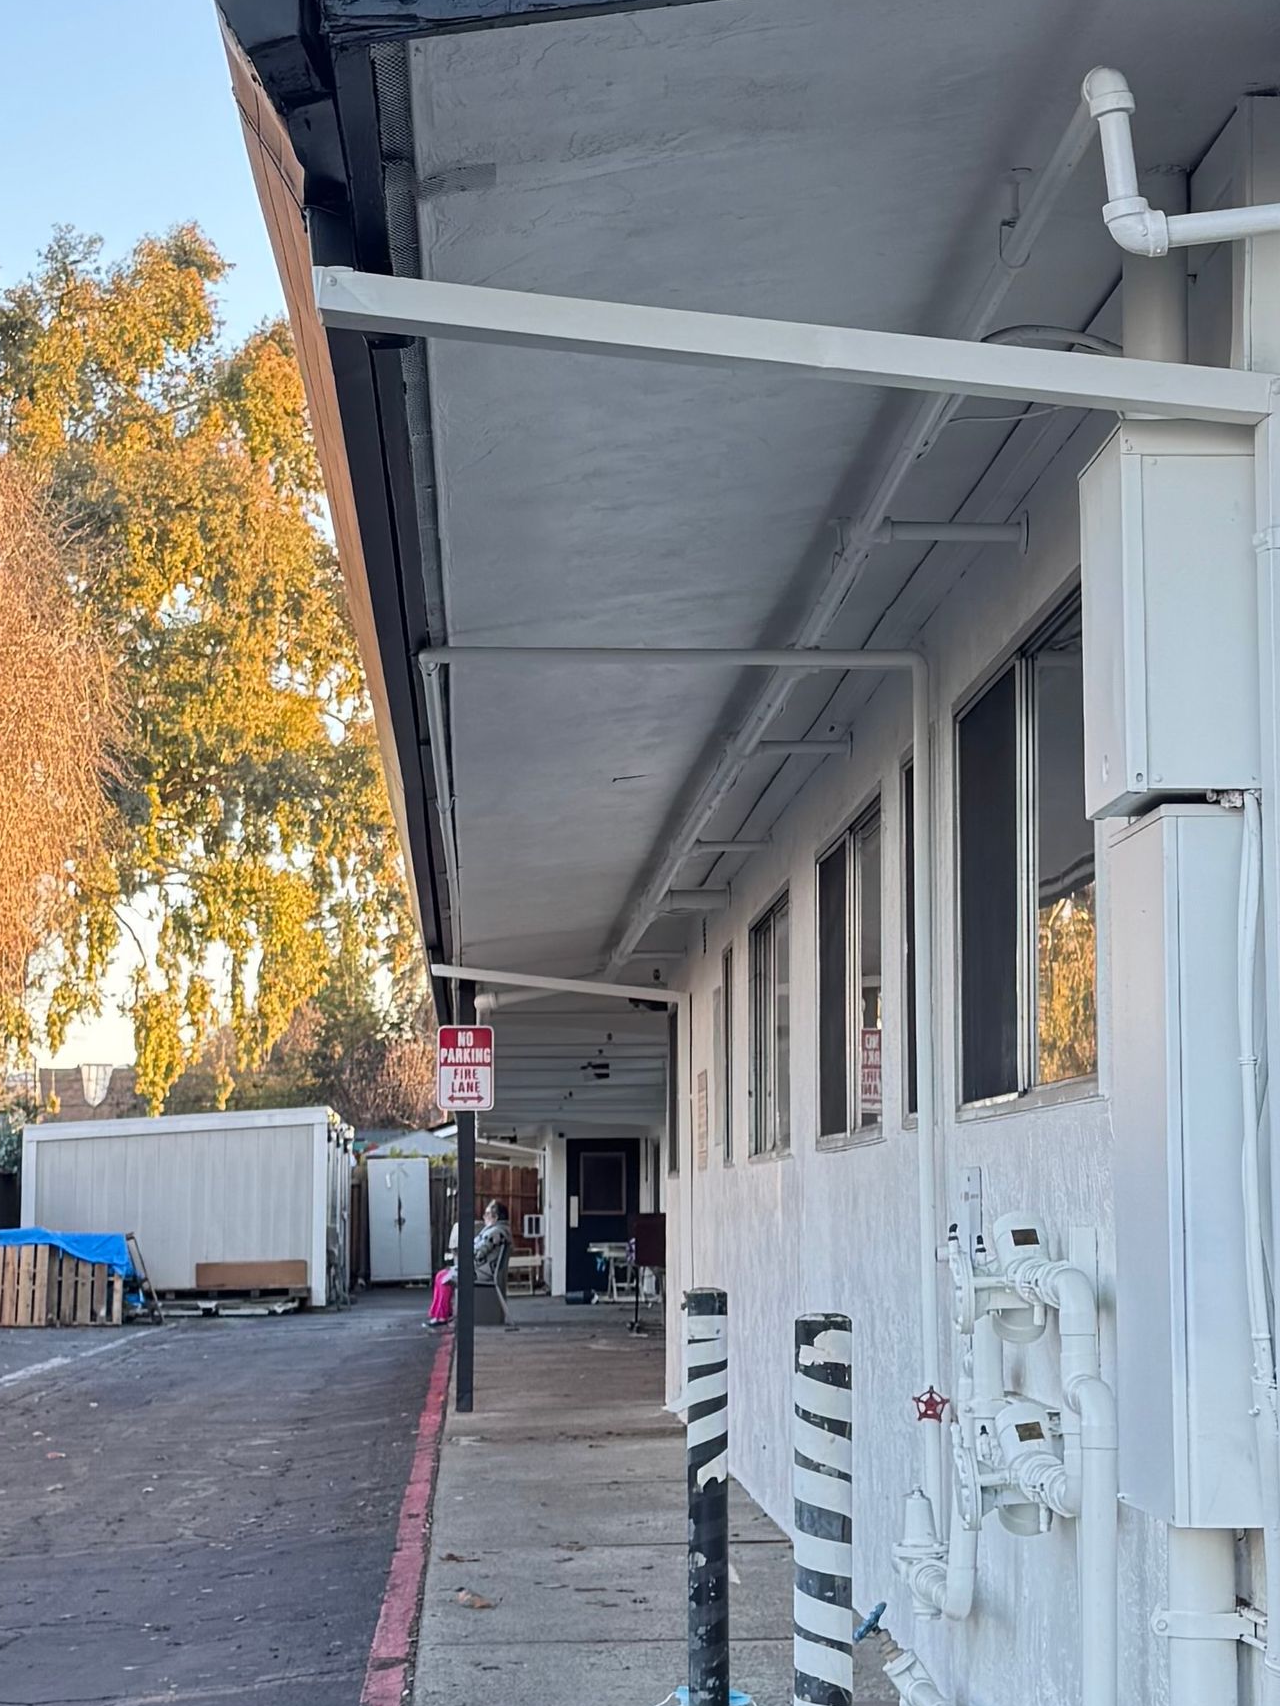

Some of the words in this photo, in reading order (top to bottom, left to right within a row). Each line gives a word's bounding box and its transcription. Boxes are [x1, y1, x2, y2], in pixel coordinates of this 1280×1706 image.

[457, 1031, 474, 1047] NO
[440, 1047, 491, 1064] PARKING
[453, 1068, 479, 1080] FIRE
[451, 1081, 480, 1093] LANE
